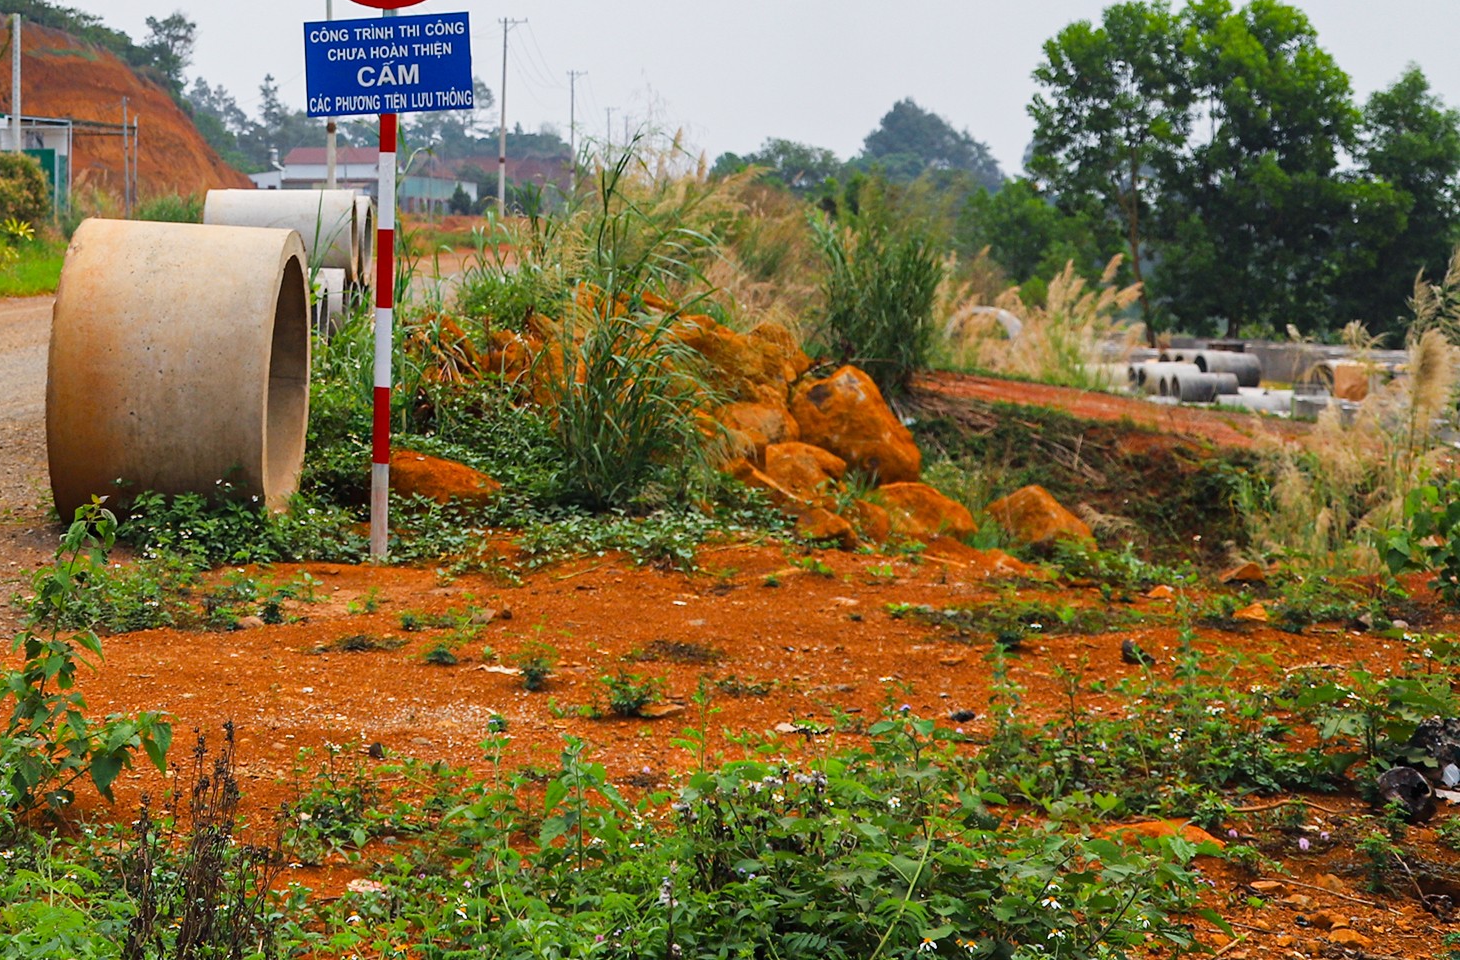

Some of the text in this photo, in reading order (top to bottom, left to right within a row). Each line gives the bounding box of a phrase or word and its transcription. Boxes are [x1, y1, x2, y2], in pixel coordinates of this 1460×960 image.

[310, 19, 465, 43] CÔNG TRÌNH THI CÔNG
[327, 41, 452, 61] CHƯA HOÀN THIỆN
[357, 61, 420, 87] CẤM
[309, 87, 473, 113] CÁC PHƯƠNG TIỆN LƯU THÔNG
